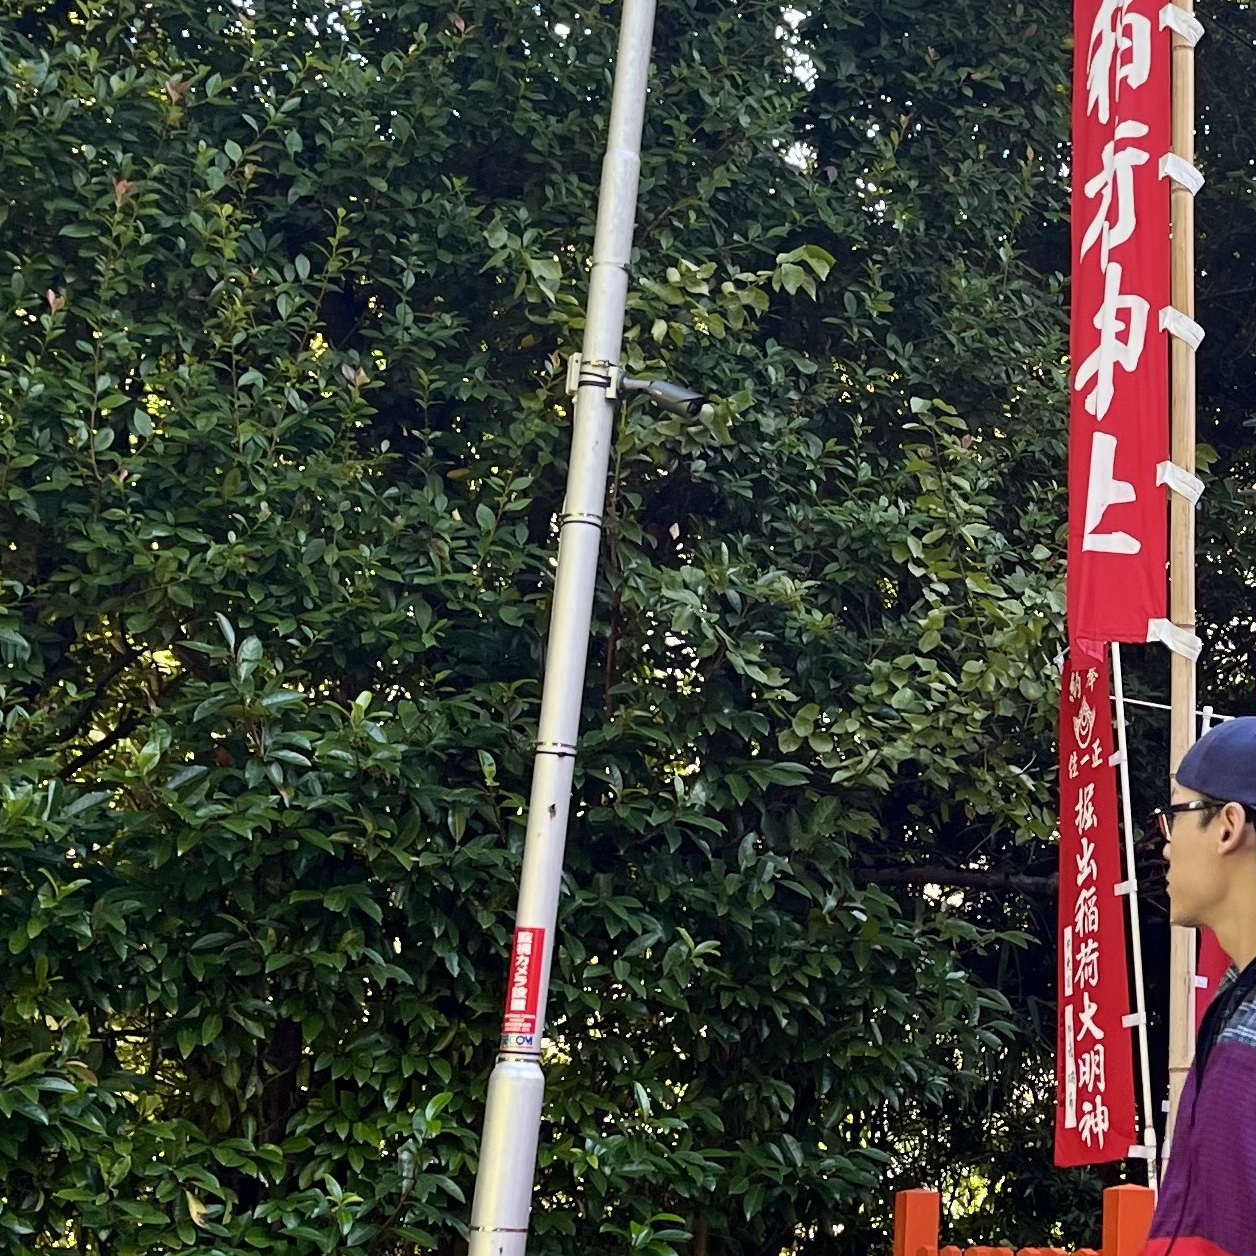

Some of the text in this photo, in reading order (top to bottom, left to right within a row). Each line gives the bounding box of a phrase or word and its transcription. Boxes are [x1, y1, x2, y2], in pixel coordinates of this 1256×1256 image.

[1068, 666, 1100, 704] 奉納
[1068, 737, 1104, 781] 正一位
